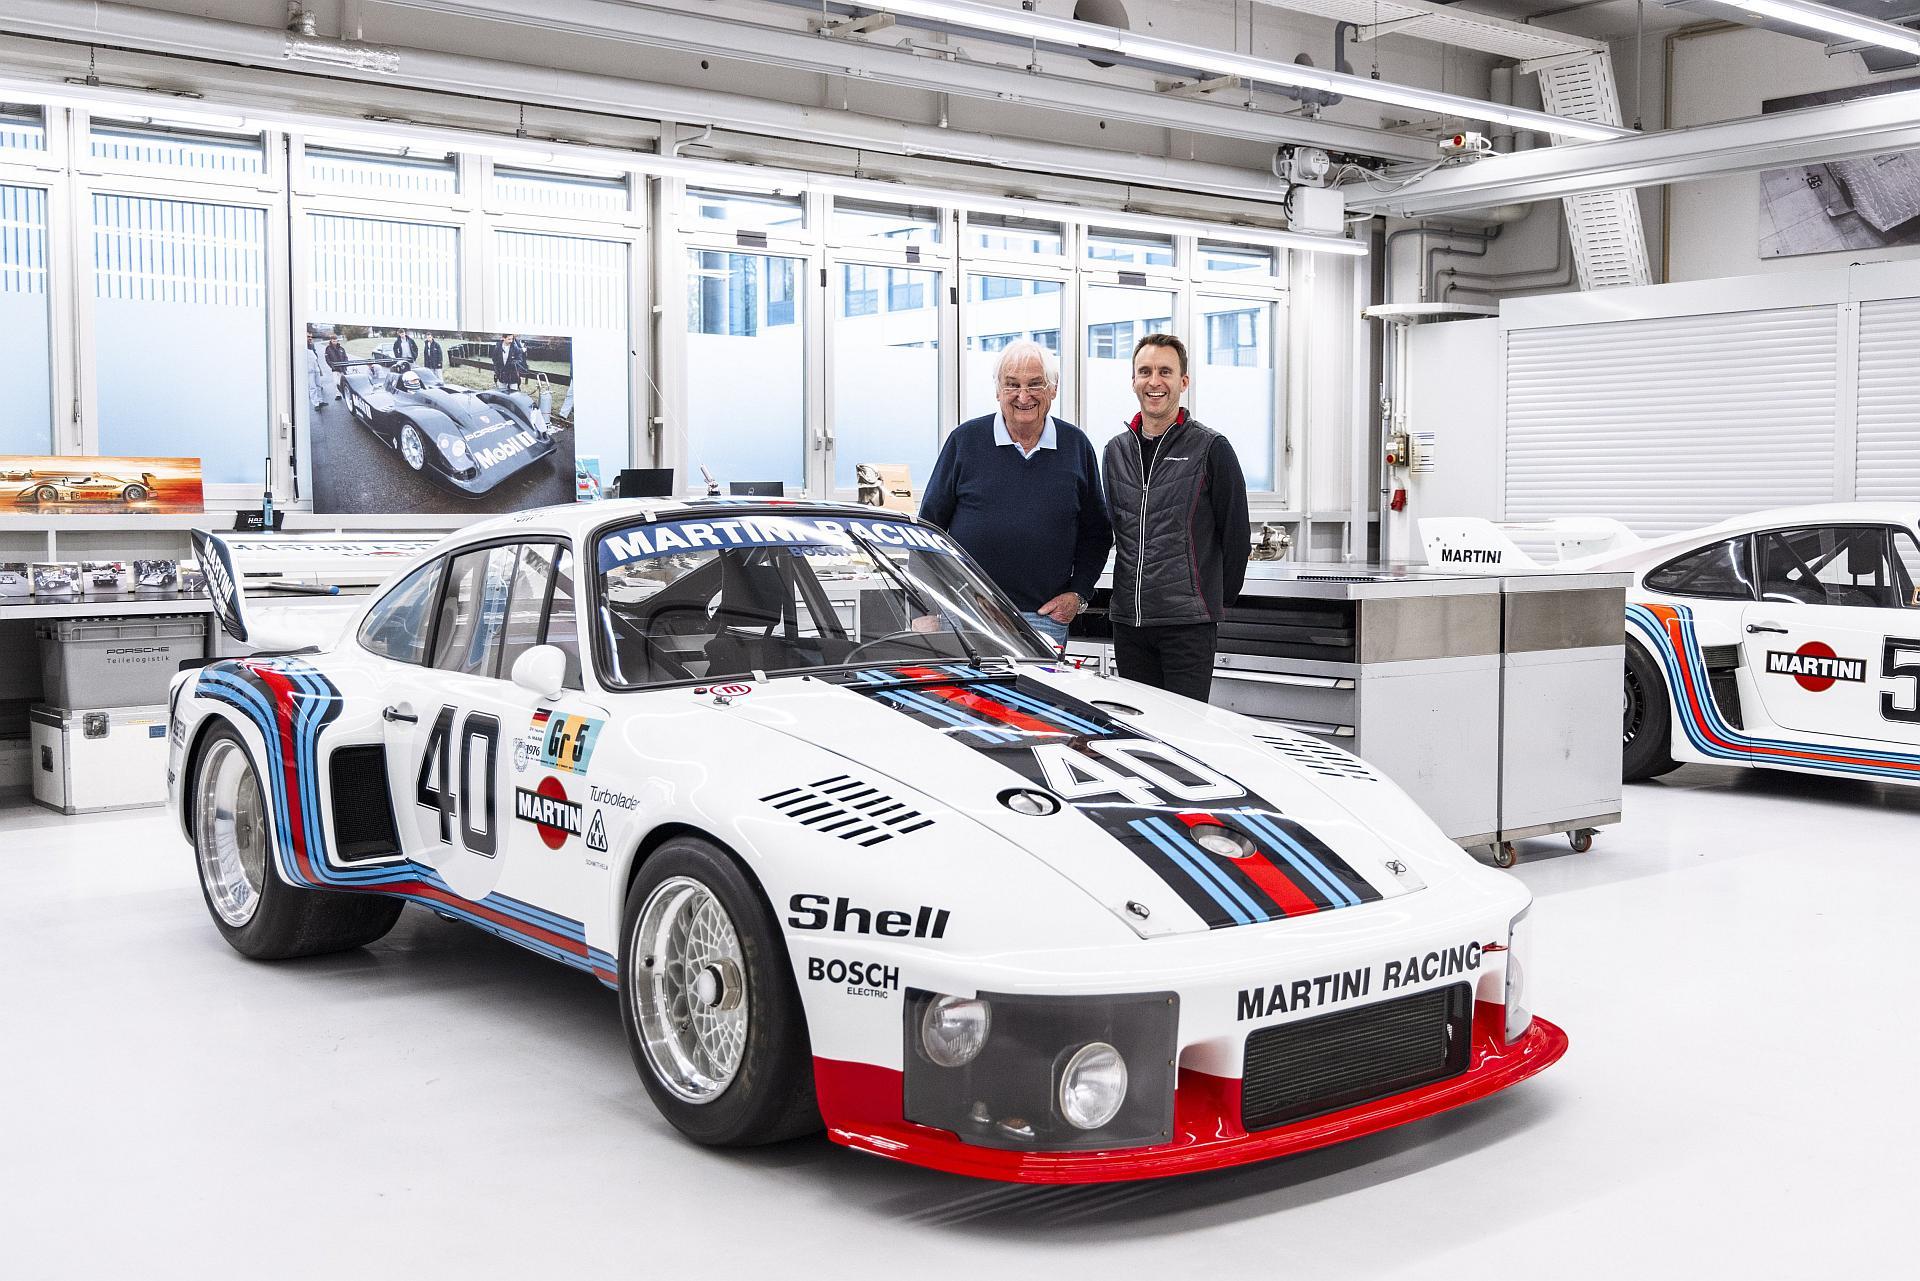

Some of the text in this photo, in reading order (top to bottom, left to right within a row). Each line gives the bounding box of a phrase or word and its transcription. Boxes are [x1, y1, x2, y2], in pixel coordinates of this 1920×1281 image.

[474, 436, 525, 470] Mobil
[605, 515, 957, 562] MARTINI RACING
[204, 536, 235, 604] MARTINI
[1441, 548, 1502, 564] MARTINI
[106, 646, 170, 655] PORSCHE
[106, 655, 170, 664] Teilelogistik
[1769, 653, 1862, 680] MARTINI
[525, 743, 541, 757] 1976
[548, 719, 570, 759] Gr
[572, 724, 590, 763] 5
[416, 703, 502, 859] 40
[1031, 738, 1248, 806] 40
[590, 785, 640, 811] Turbolader
[787, 893, 952, 939] Shell
[808, 956, 900, 990] BOSCH
[1236, 941, 1482, 1021] MARTINI RACING
[846, 986, 888, 999] ELECTRIC
